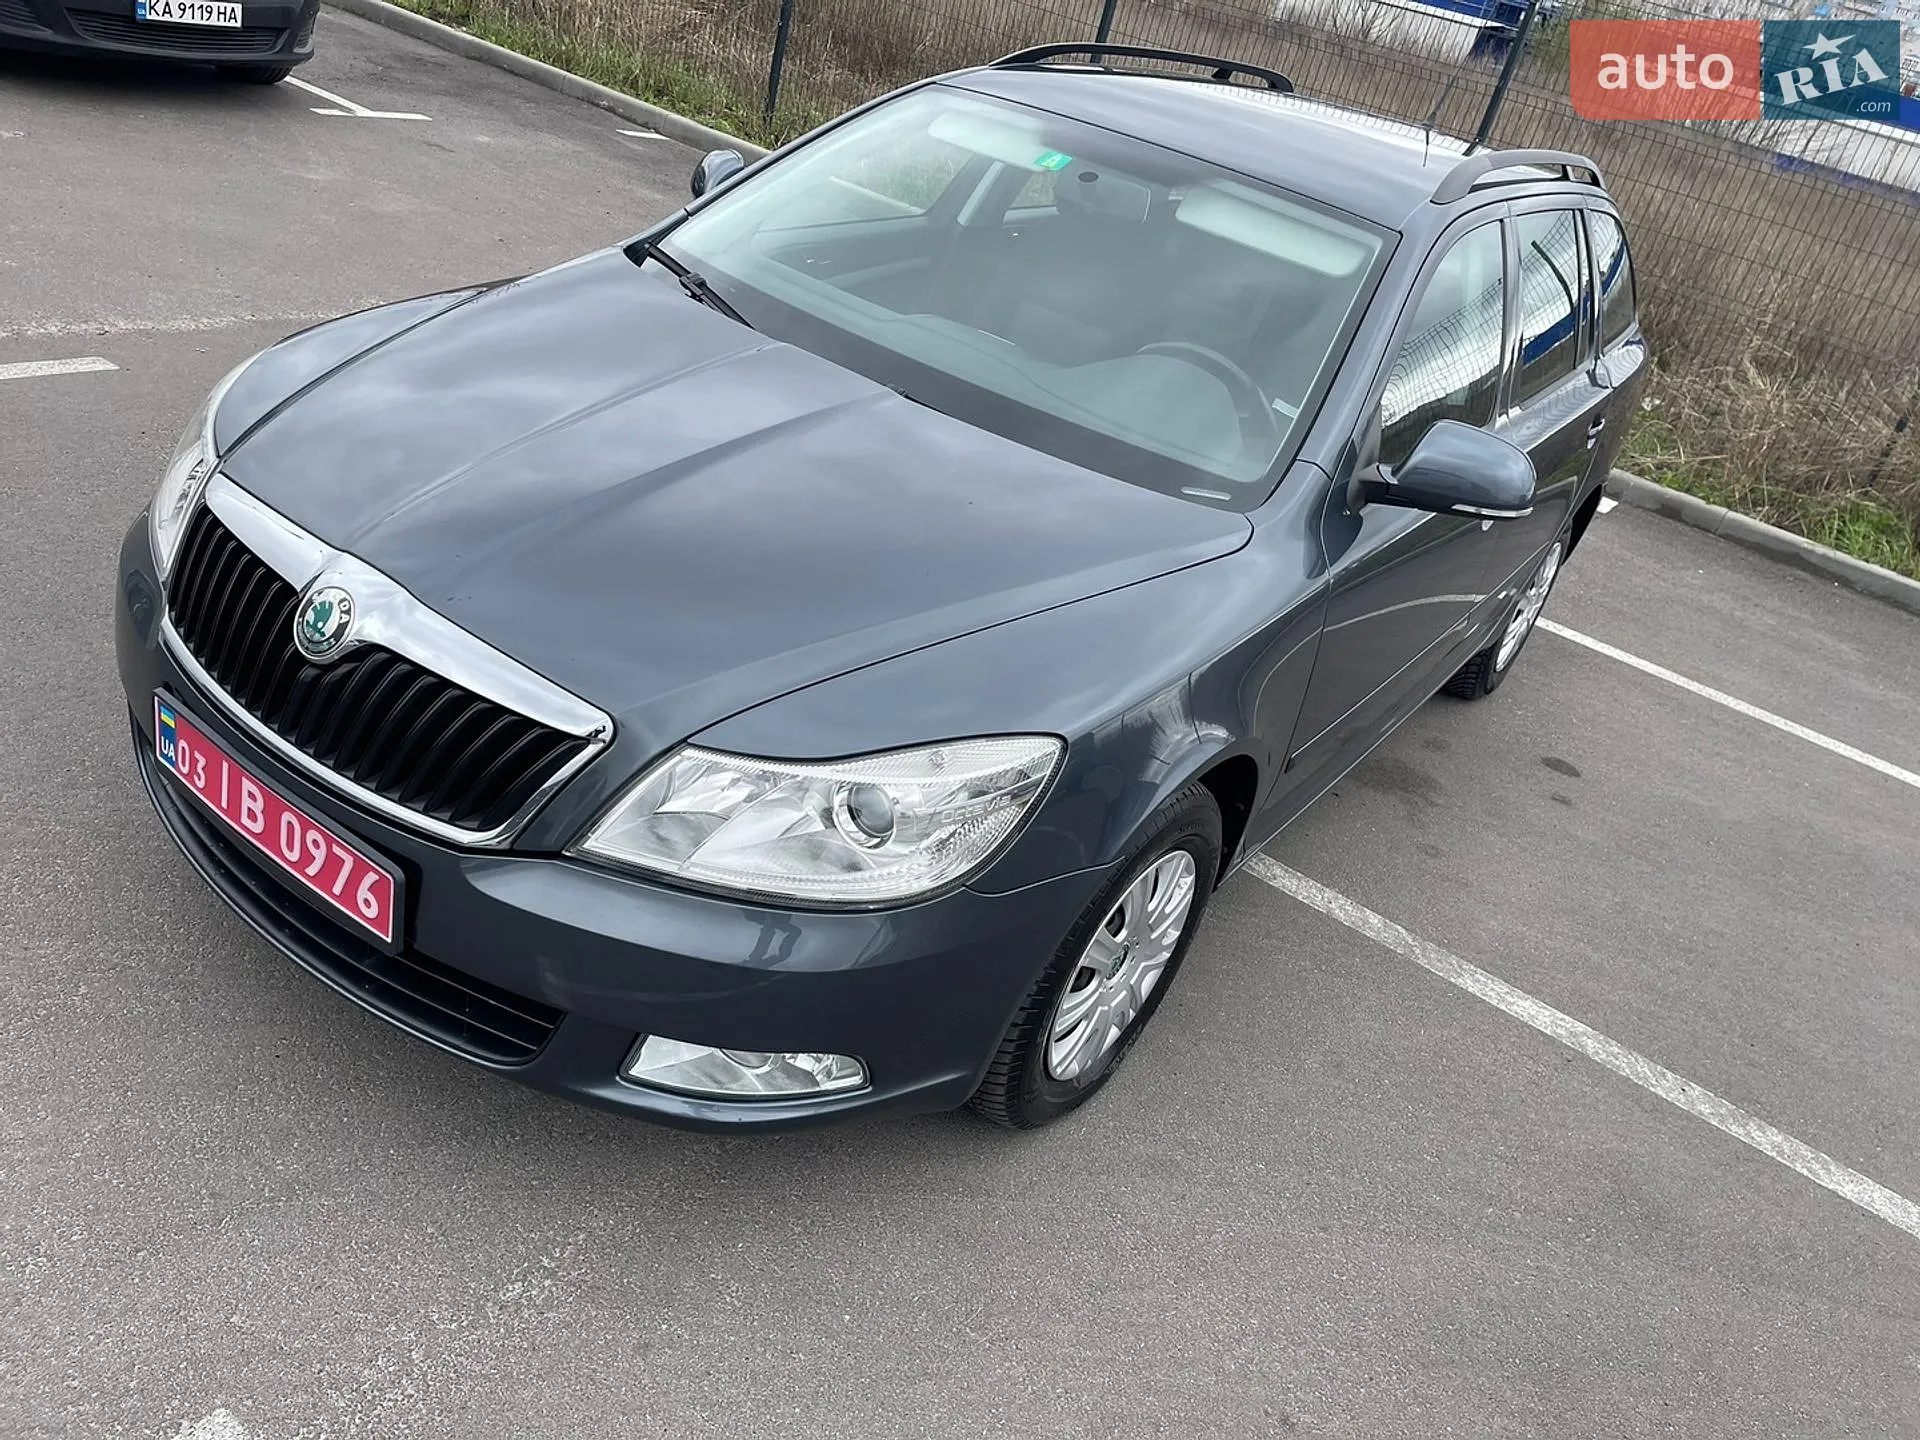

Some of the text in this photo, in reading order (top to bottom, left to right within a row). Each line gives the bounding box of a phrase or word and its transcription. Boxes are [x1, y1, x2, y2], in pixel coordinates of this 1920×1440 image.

[148, 0, 238, 23] KA 9119 HA
[161, 736, 176, 762] UA
[177, 739, 380, 919] 03 IB 0976
